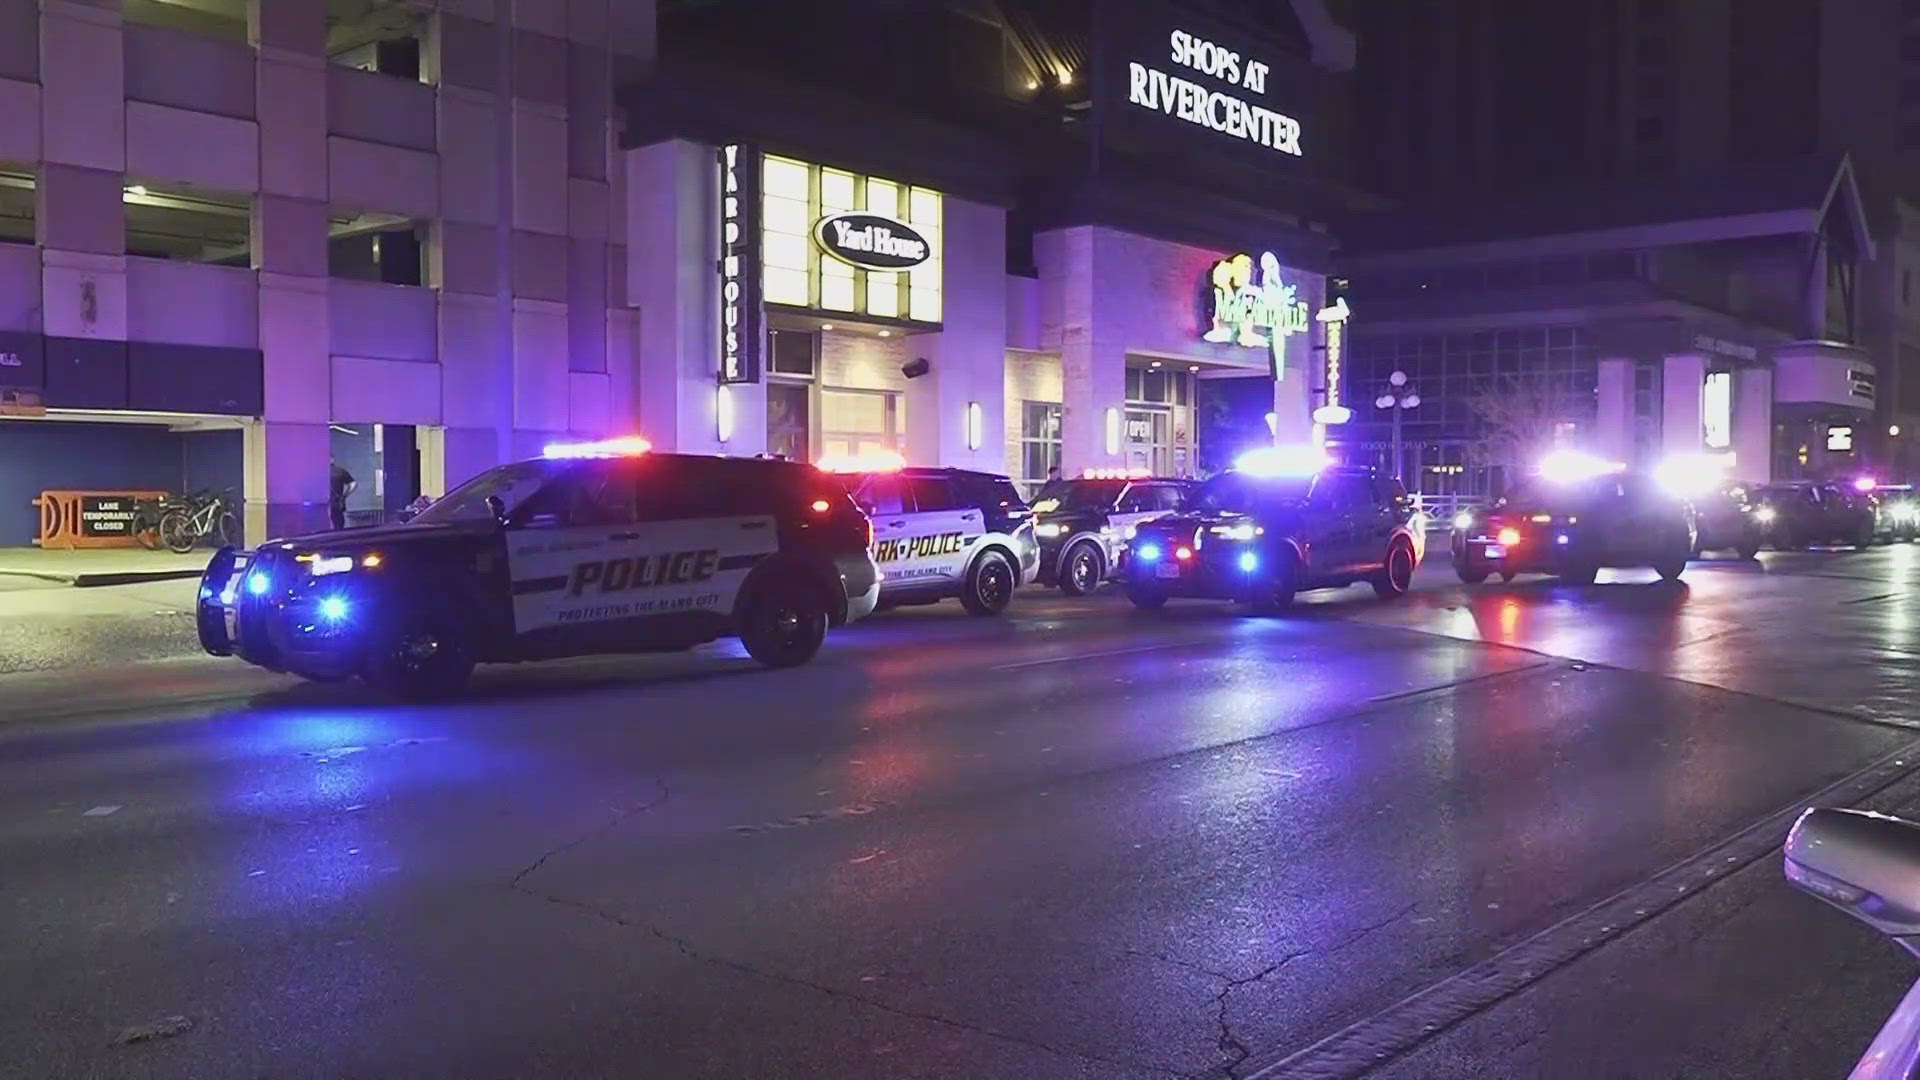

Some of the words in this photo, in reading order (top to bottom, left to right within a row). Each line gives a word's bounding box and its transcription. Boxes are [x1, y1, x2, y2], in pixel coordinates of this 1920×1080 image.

[1170, 29, 1240, 85] SHOPS
[1242, 59, 1269, 94] AT
[1129, 61, 1302, 156] RIVERCENTER
[724, 145, 738, 244] YARD
[832, 220, 872, 251] Yard
[873, 226, 925, 260] House
[724, 255, 739, 378] HOUSE
[83, 512, 135, 520] TEMPORARILY
[98, 502, 119, 510] LANE
[93, 522, 124, 530] CLOSED
[872, 537, 901, 562] RK
[907, 532, 963, 559] POLICE
[569, 549, 719, 597] POLICE
[904, 569, 916, 577] THE
[559, 604, 630, 621] PROTECTING
[634, 601, 653, 613] THE
[696, 594, 720, 606] CITY
